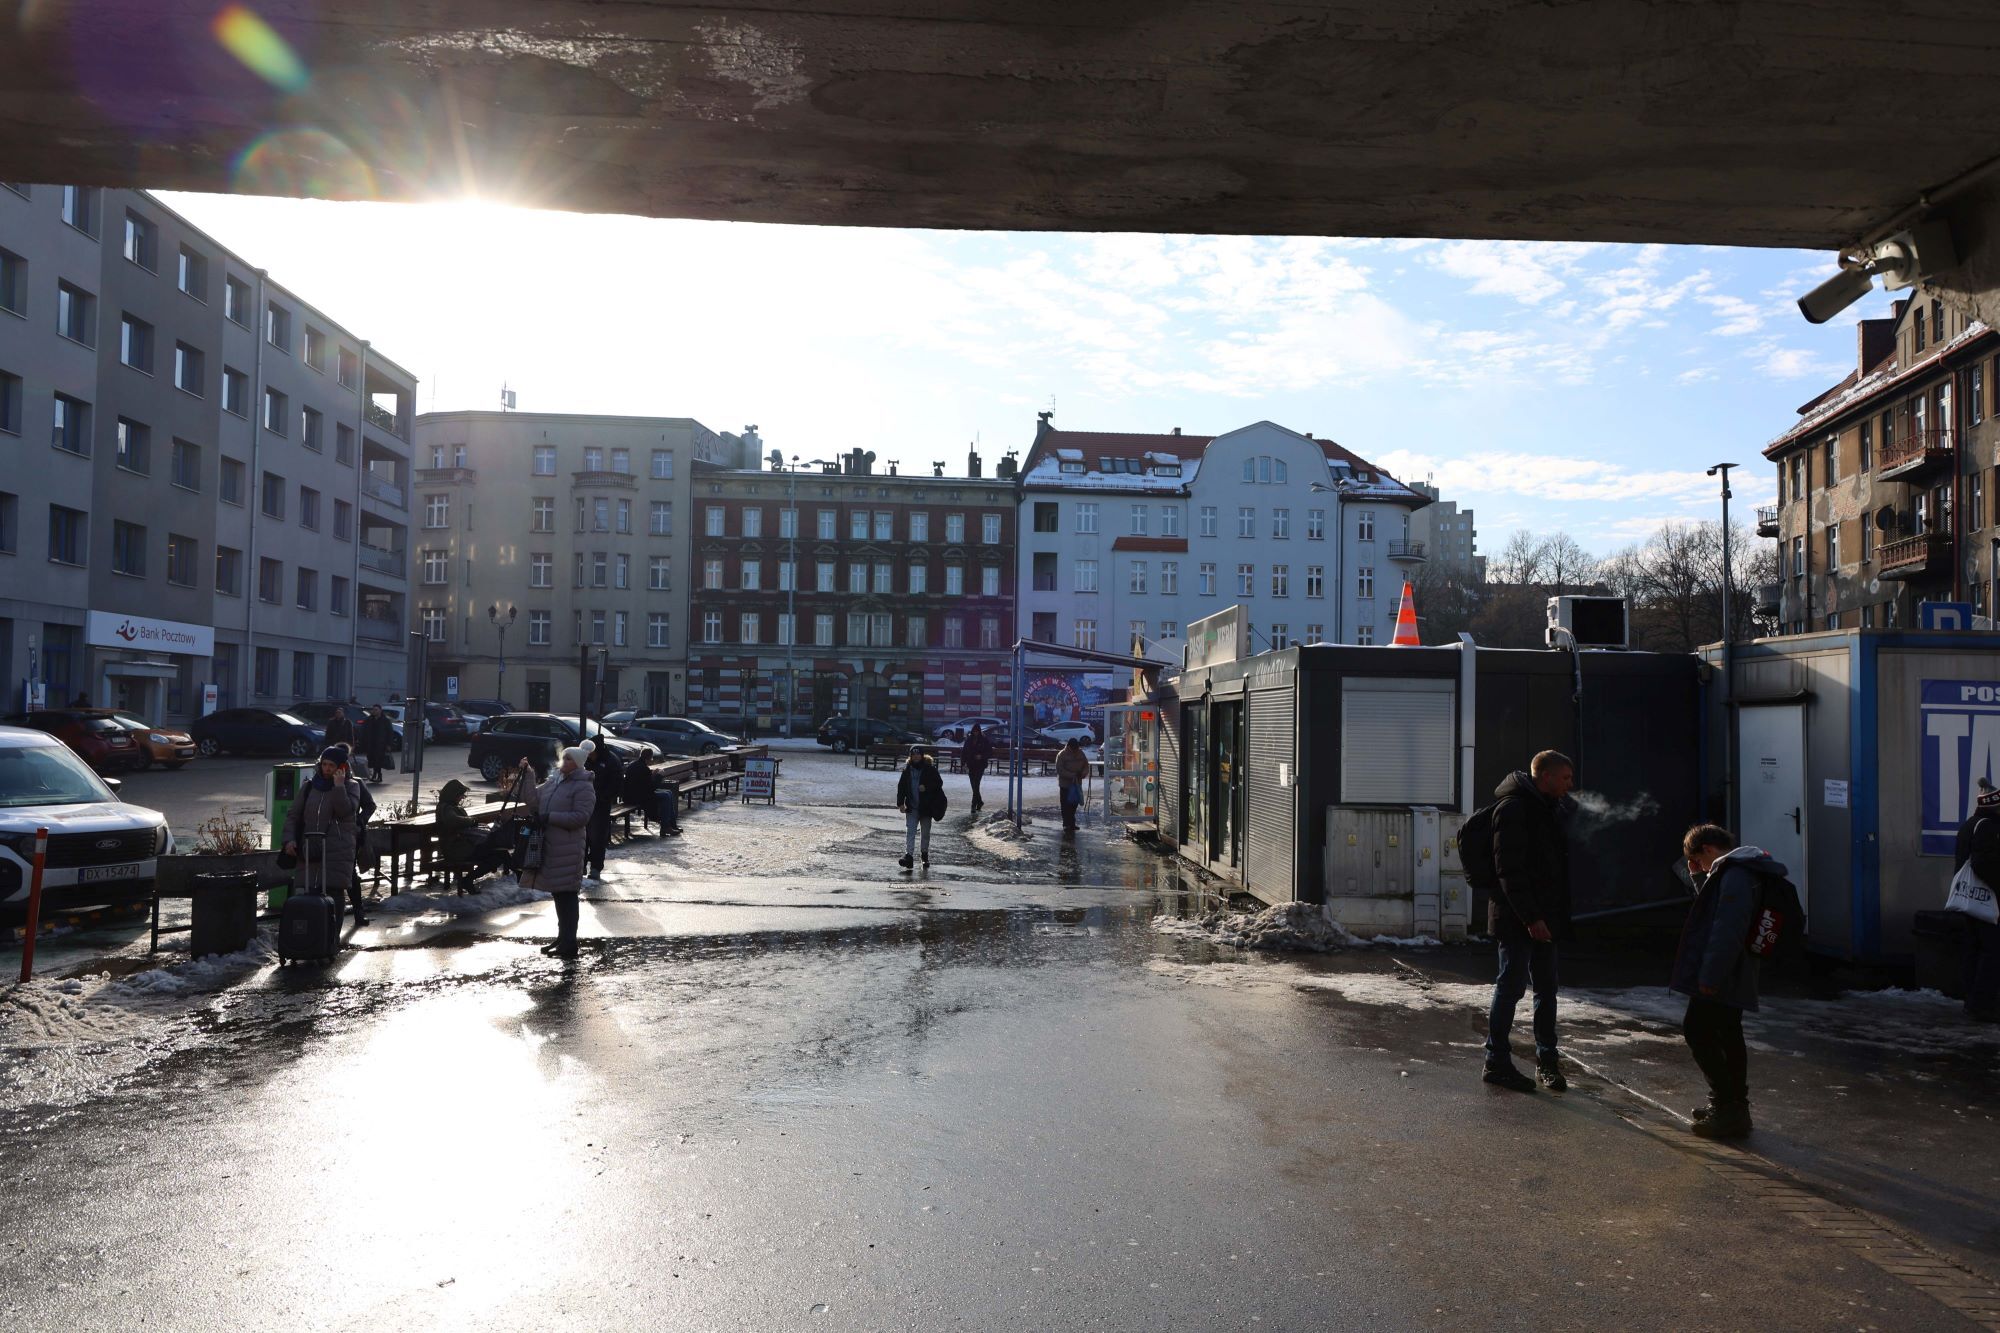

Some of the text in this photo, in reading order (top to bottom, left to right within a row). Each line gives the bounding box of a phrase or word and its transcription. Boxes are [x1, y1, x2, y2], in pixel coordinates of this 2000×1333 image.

[140, 627, 196, 646] Bank Pocztowy
[86, 866, 136, 881] DX 15474
